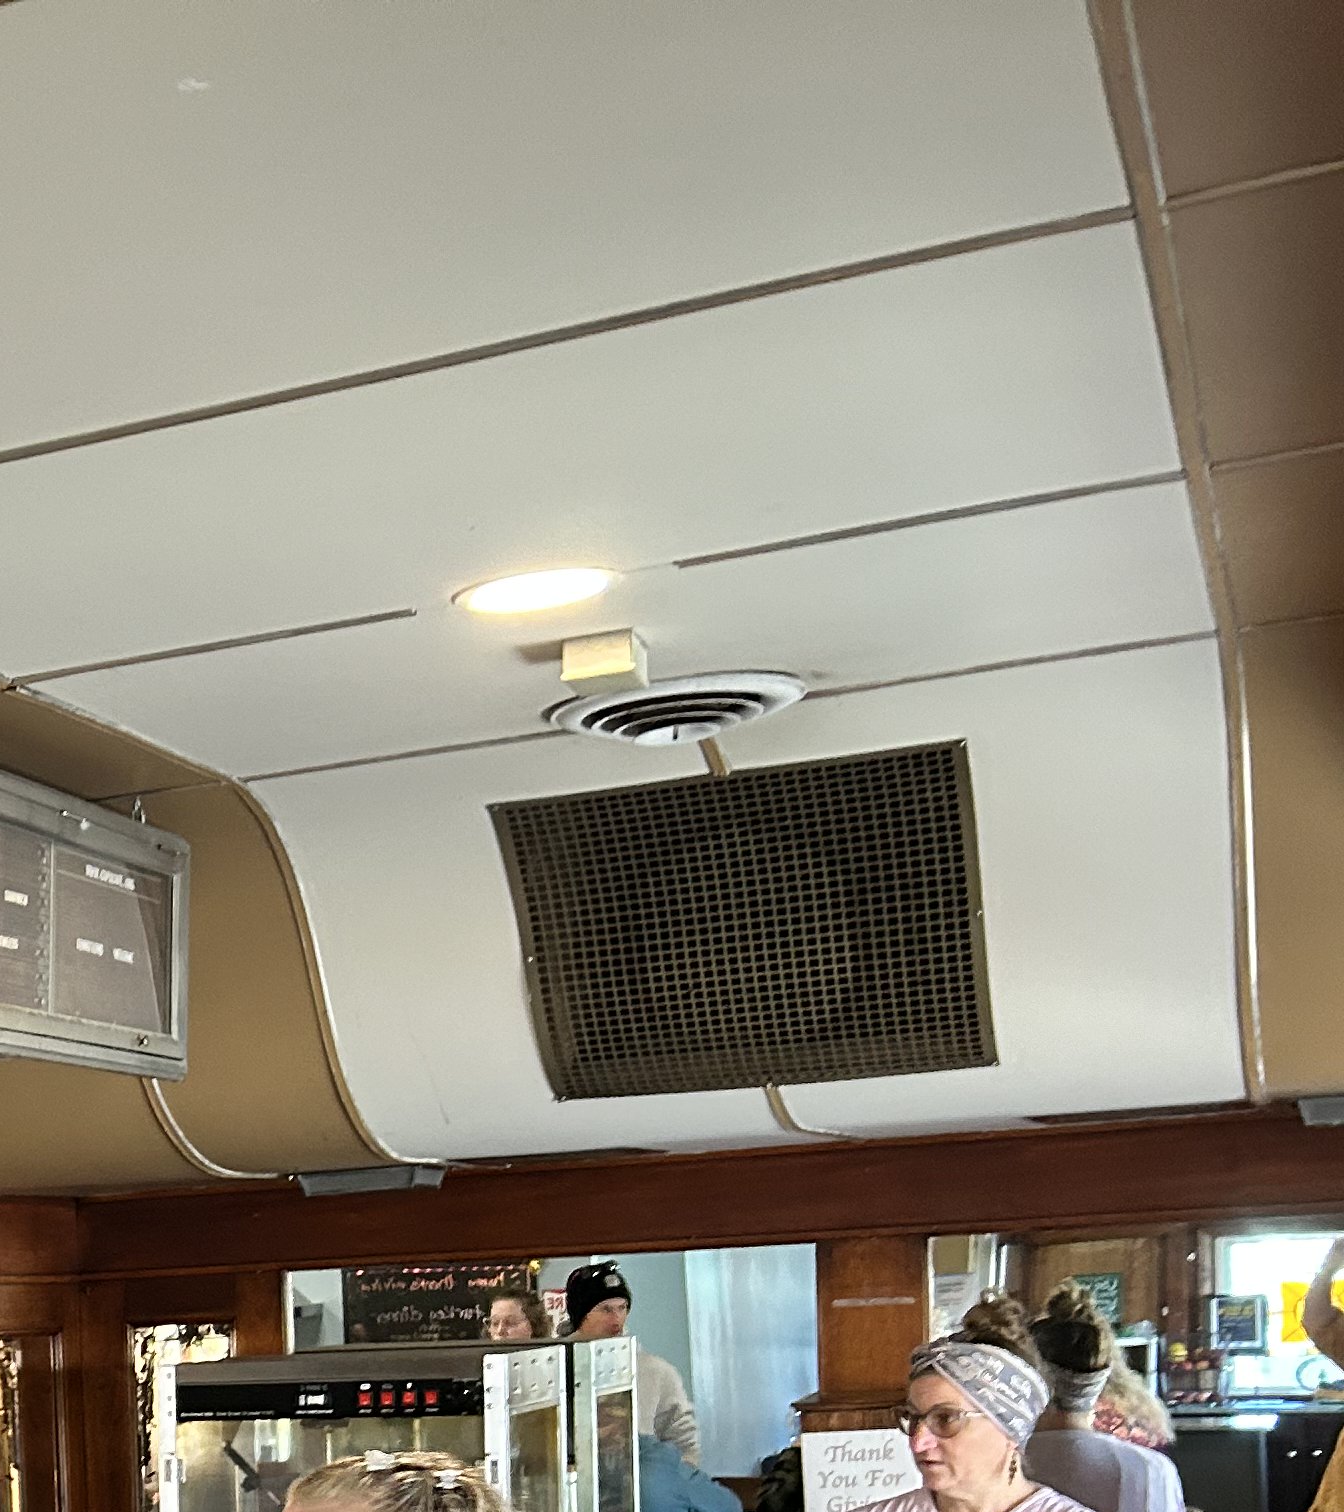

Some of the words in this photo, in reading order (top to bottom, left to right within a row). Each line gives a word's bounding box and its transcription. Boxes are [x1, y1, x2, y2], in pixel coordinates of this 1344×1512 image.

[824, 1438, 896, 1463] Thank
[817, 1470, 858, 1489] You
[865, 1469, 907, 1487] For
